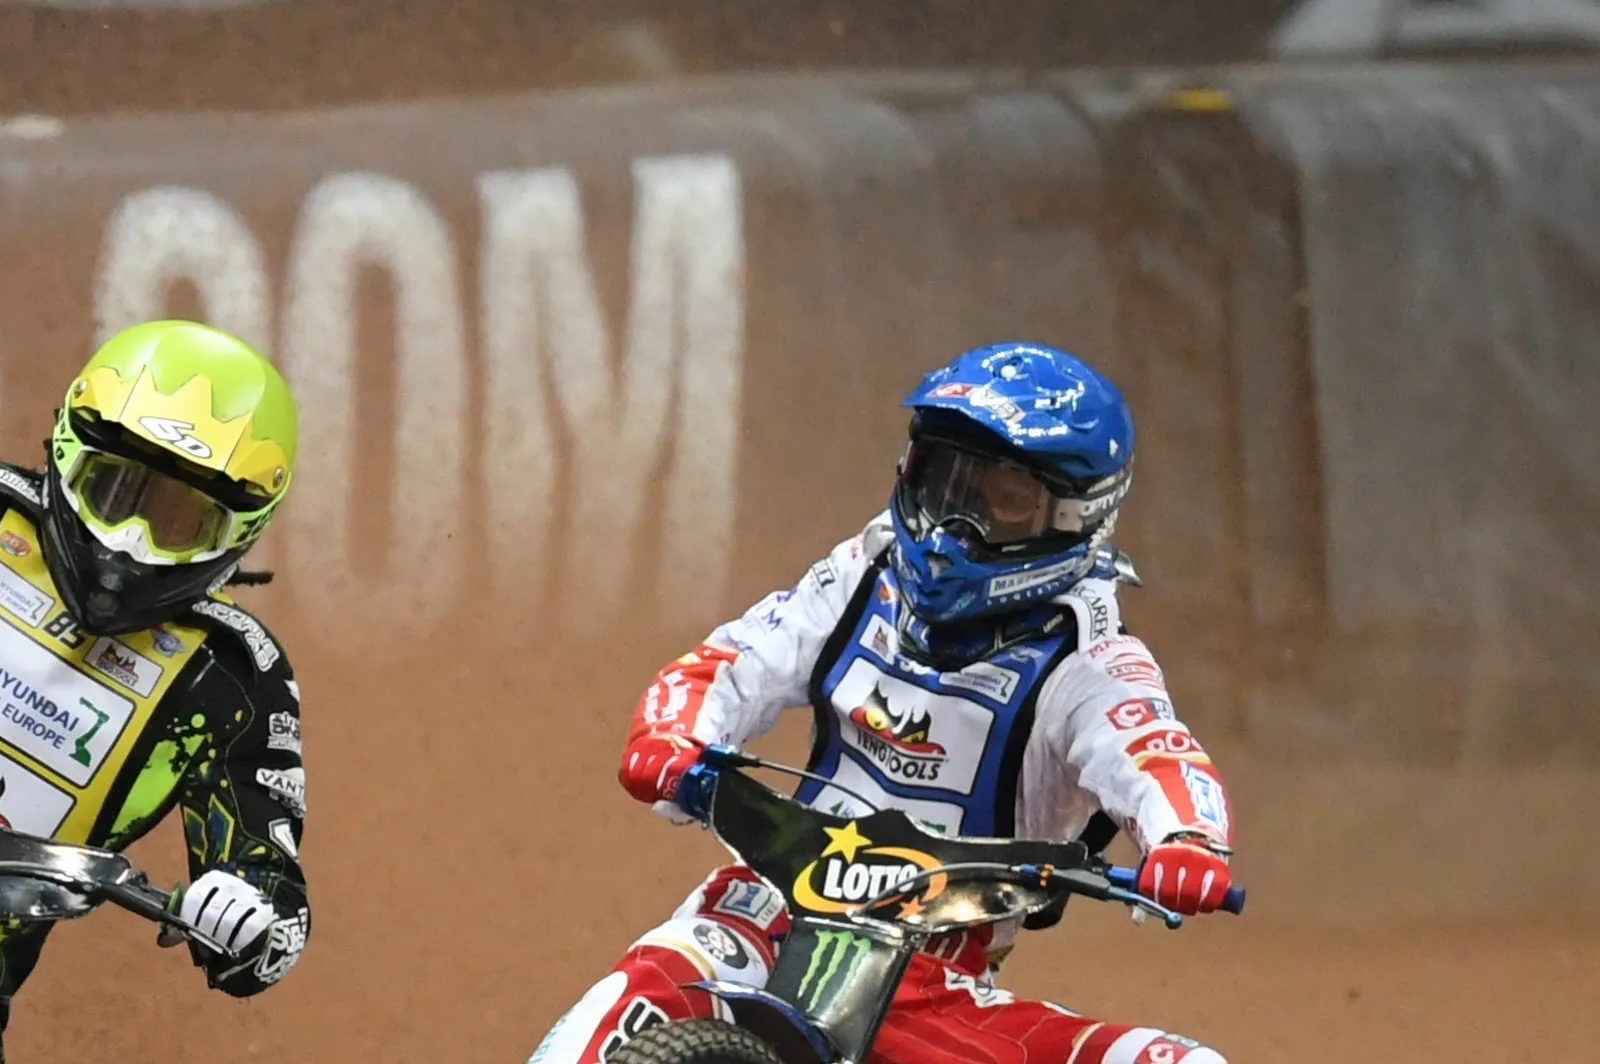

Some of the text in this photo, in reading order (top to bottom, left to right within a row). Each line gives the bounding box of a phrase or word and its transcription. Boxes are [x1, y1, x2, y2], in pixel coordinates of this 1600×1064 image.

[42, 610, 86, 650] 85
[1, 702, 67, 750] EUROPE
[856, 729, 945, 781] TENGTOOLS
[823, 858, 918, 901] LOTTO
